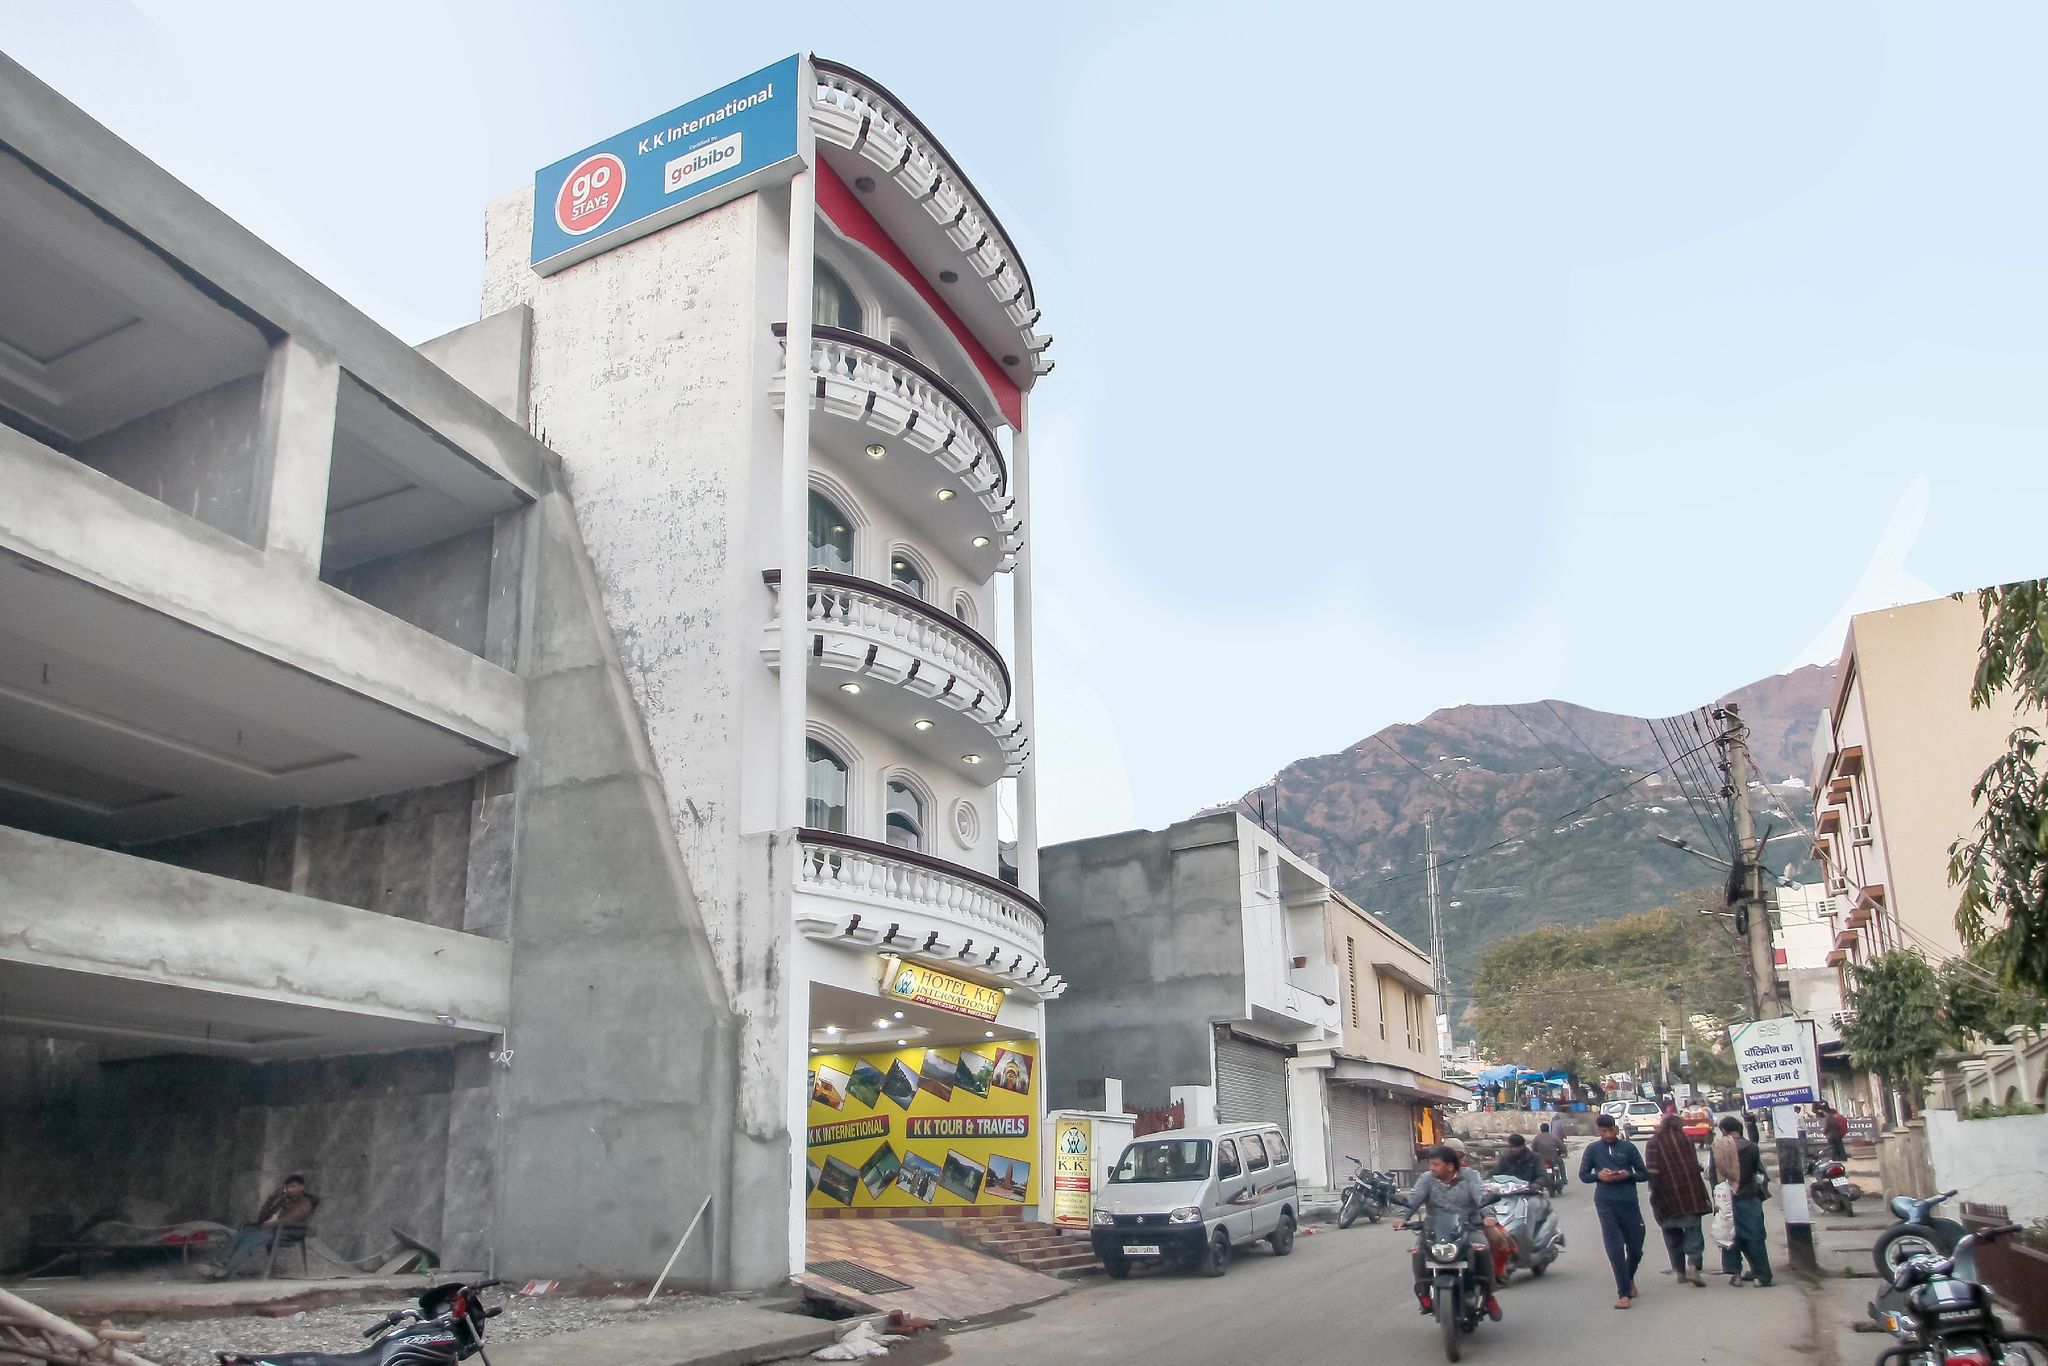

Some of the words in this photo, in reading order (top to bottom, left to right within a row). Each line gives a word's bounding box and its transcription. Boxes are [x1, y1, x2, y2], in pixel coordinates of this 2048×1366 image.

[638, 132, 664, 156] K.K
[667, 83, 774, 143] International
[689, 138, 711, 150] Certified
[671, 146, 735, 185] goibibo
[572, 166, 611, 206] go
[572, 192, 609, 217] STAYS
[920, 971, 967, 996] HOTEL
[973, 988, 998, 1006] K.K.
[916, 986, 995, 1013] INTERNATIONAL
[1744, 1044, 1780, 1057] पॉलिथीन
[1781, 1044, 1794, 1052] का
[1742, 1060, 1777, 1073] इस्तेमाल
[1779, 1056, 1802, 1067] करना
[1751, 1074, 1772, 1085] सख्त
[1774, 1072, 1791, 1081] मना
[1793, 1069, 1800, 1080] है
[1749, 1092, 1777, 1100] MUNICIPAL
[1779, 1088, 1809, 1097] COMMITTEE
[815, 1128, 822, 1142] K
[823, 1120, 884, 1141] INTERNETIONAL
[914, 1120, 920, 1134] K
[924, 1120, 931, 1134] K
[934, 1119, 963, 1134] TOUR
[966, 1119, 974, 1134] &
[977, 1118, 1025, 1134] TRAVELS
[1058, 1161, 1088, 1171] K.K.
